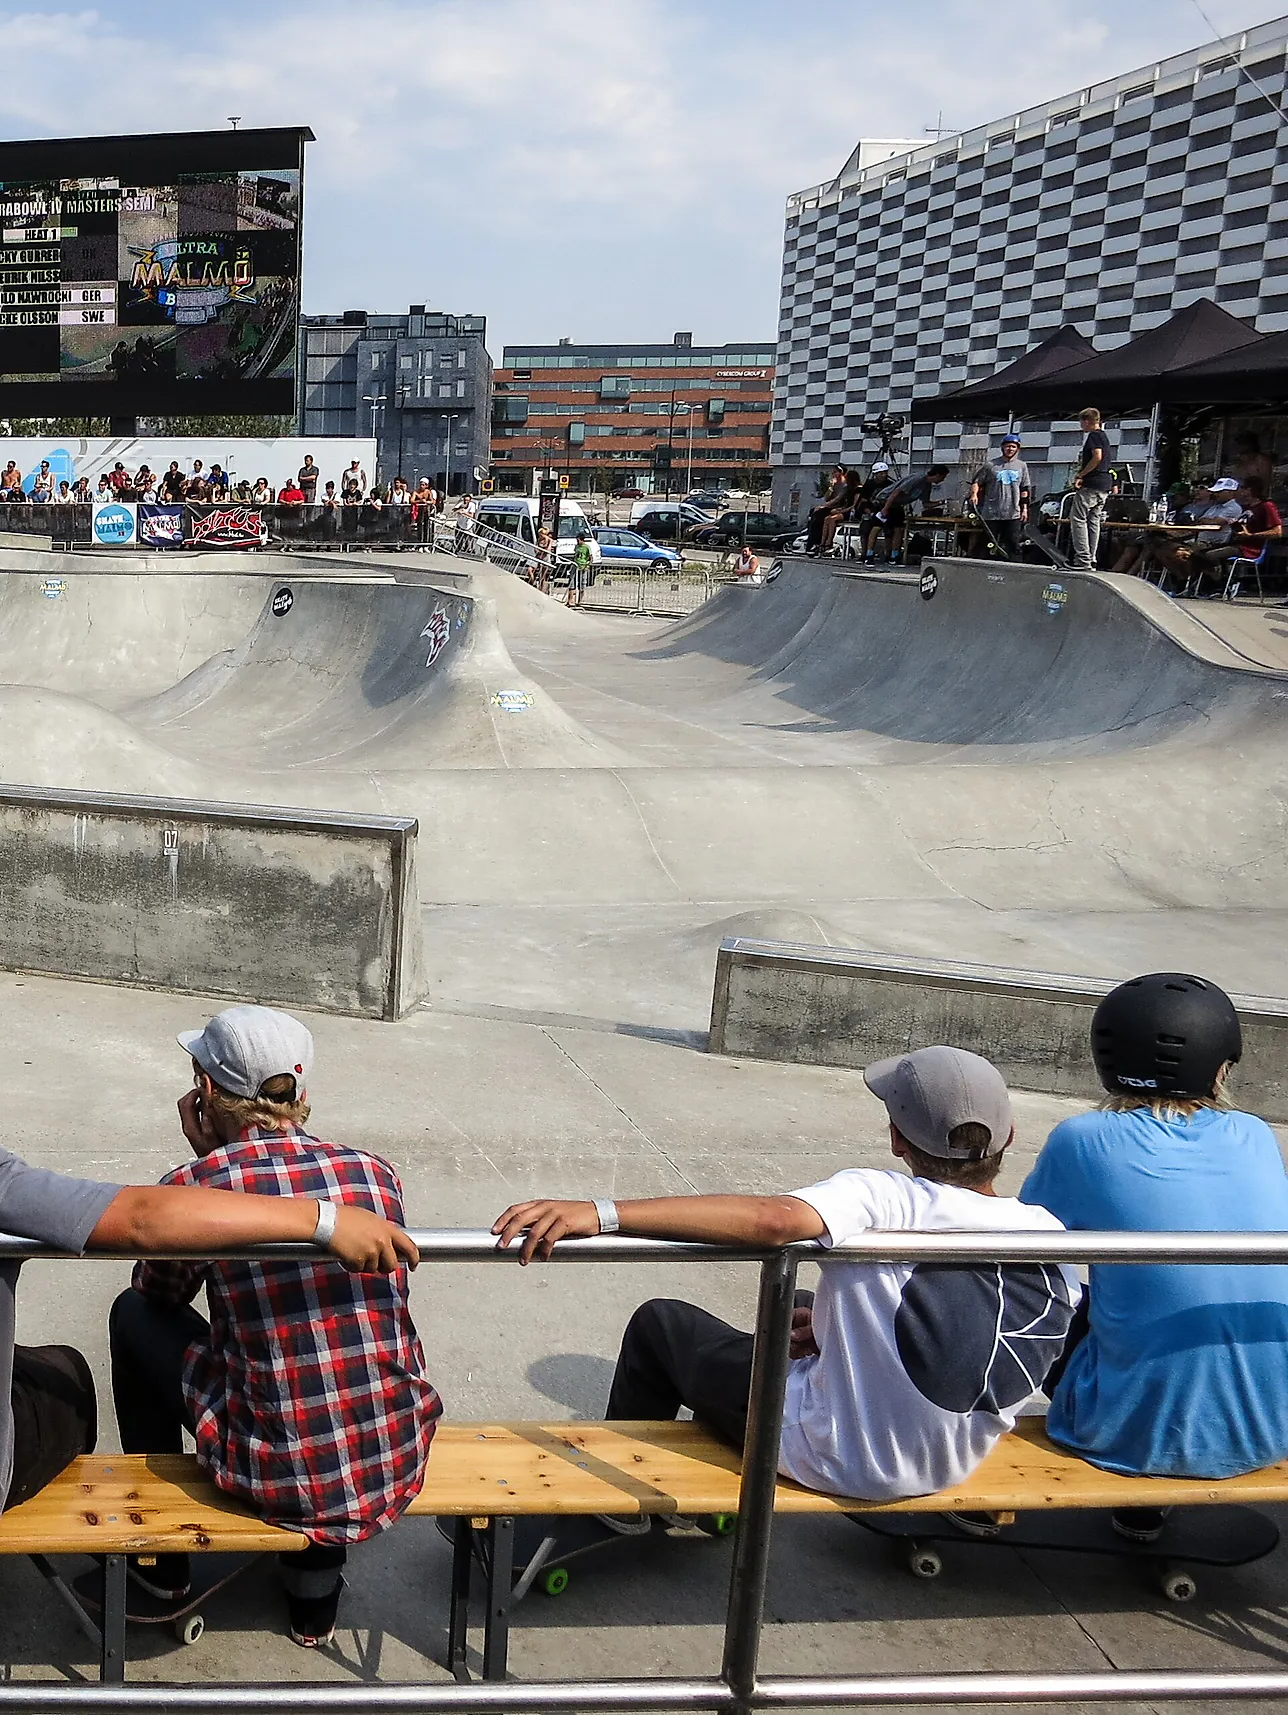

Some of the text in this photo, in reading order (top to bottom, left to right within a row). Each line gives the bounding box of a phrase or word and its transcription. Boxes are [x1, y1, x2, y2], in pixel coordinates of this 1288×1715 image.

[67, 198, 122, 214] MASTERS
[126, 196, 156, 211] SEMI
[24, 229, 57, 240] HEAT 1
[169, 241, 219, 256] LTRA
[131, 246, 253, 288] MALMÖ
[17, 290, 72, 304] NAWROCKI
[82, 290, 101, 302] GER
[19, 311, 59, 325] OLSSON
[81, 310, 105, 323] SWE
[164, 830, 178, 848] 07
